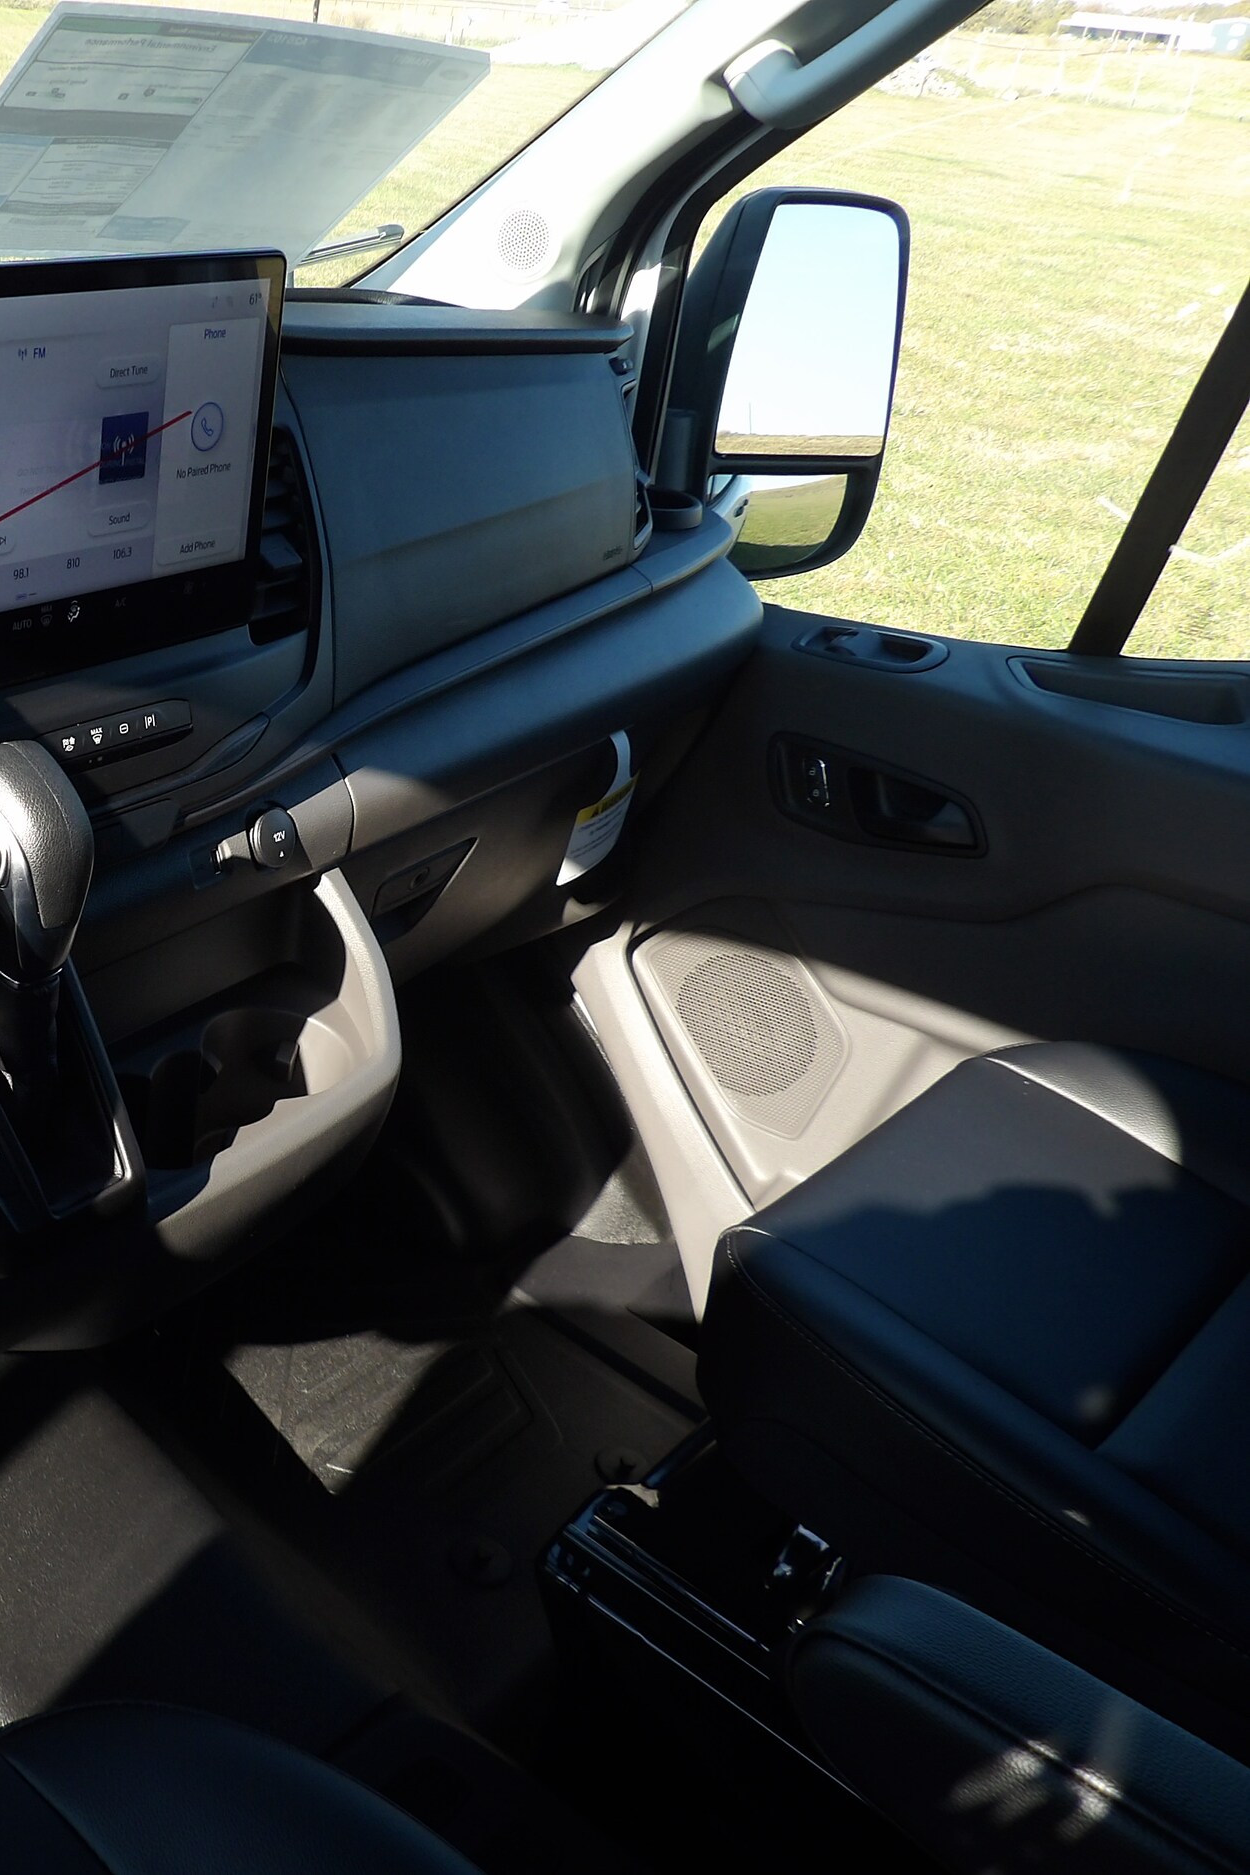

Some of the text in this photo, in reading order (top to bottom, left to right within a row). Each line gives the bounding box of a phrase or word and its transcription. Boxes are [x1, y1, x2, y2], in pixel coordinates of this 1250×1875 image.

[204, 327, 227, 340] Phone
[33, 347, 46, 360] FM
[110, 363, 148, 379] Direct Tune
[176, 461, 231, 480] No Paired Phone
[109, 512, 130, 525] Sound
[180, 538, 216, 555] Add Phone
[13, 567, 30, 580] 98.1
[66, 557, 80, 570] 810
[113, 547, 132, 560] 106.3
[12, 618, 32, 630] AUTO
[90, 727, 103, 735] MAX
[273, 830, 285, 843] 12V
